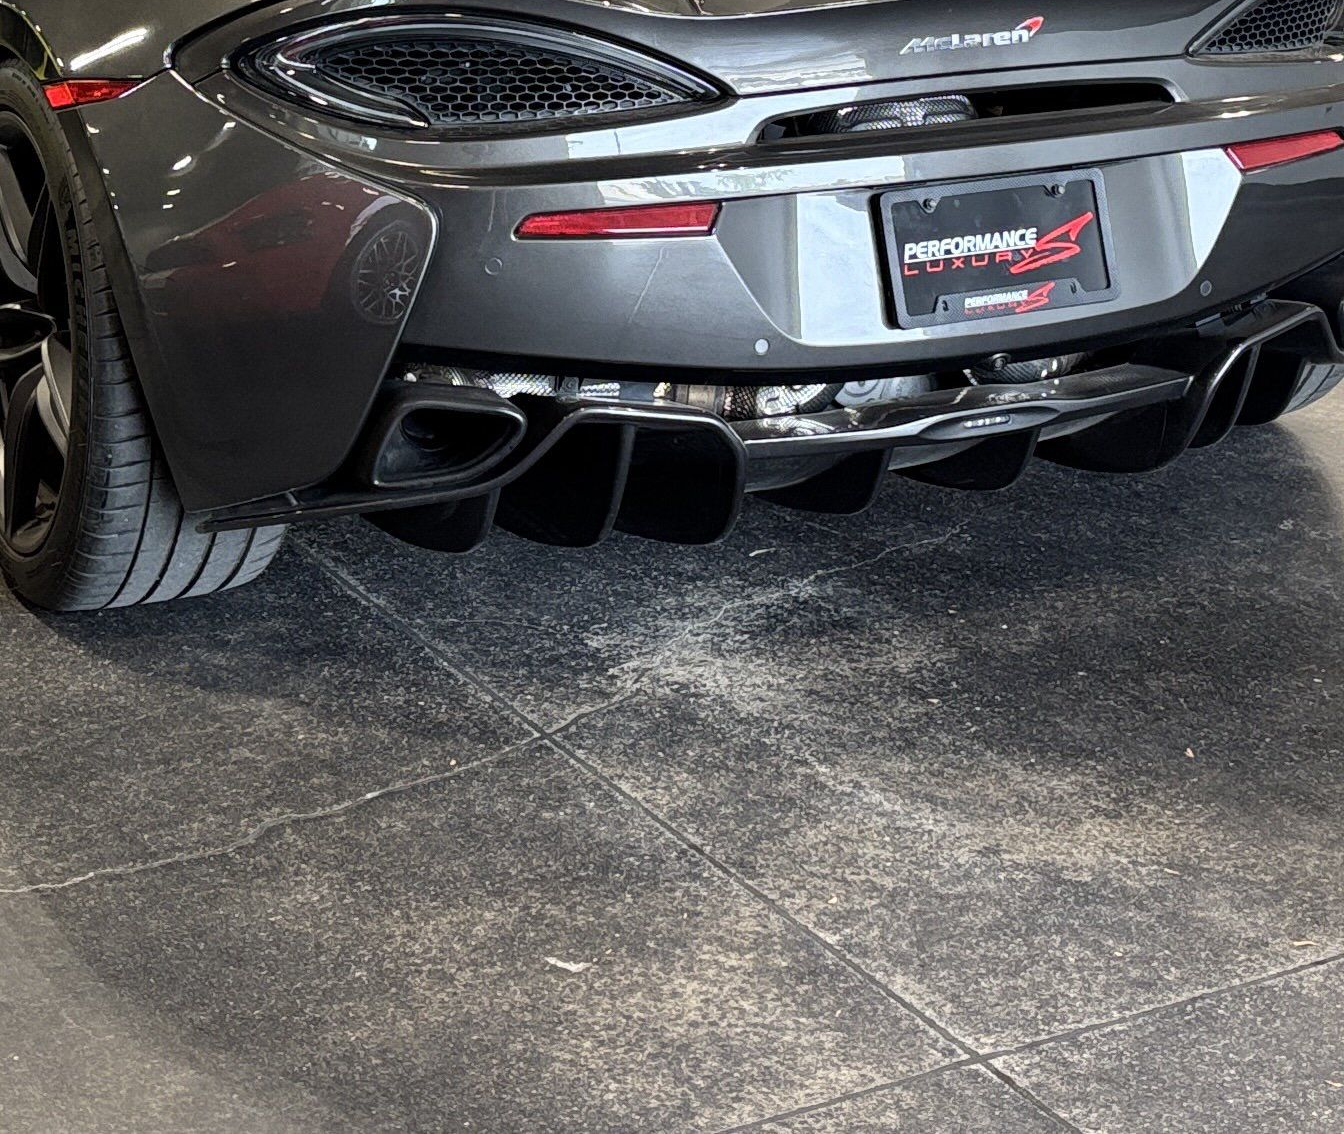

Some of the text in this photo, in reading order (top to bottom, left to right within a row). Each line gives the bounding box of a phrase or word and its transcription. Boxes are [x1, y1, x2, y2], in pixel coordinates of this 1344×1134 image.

[899, 28, 1030, 55] McLaren
[904, 227, 1038, 259] PERFORMANCE
[904, 248, 1035, 275] LUXURY
[964, 289, 1029, 308] PERFORMANCE
